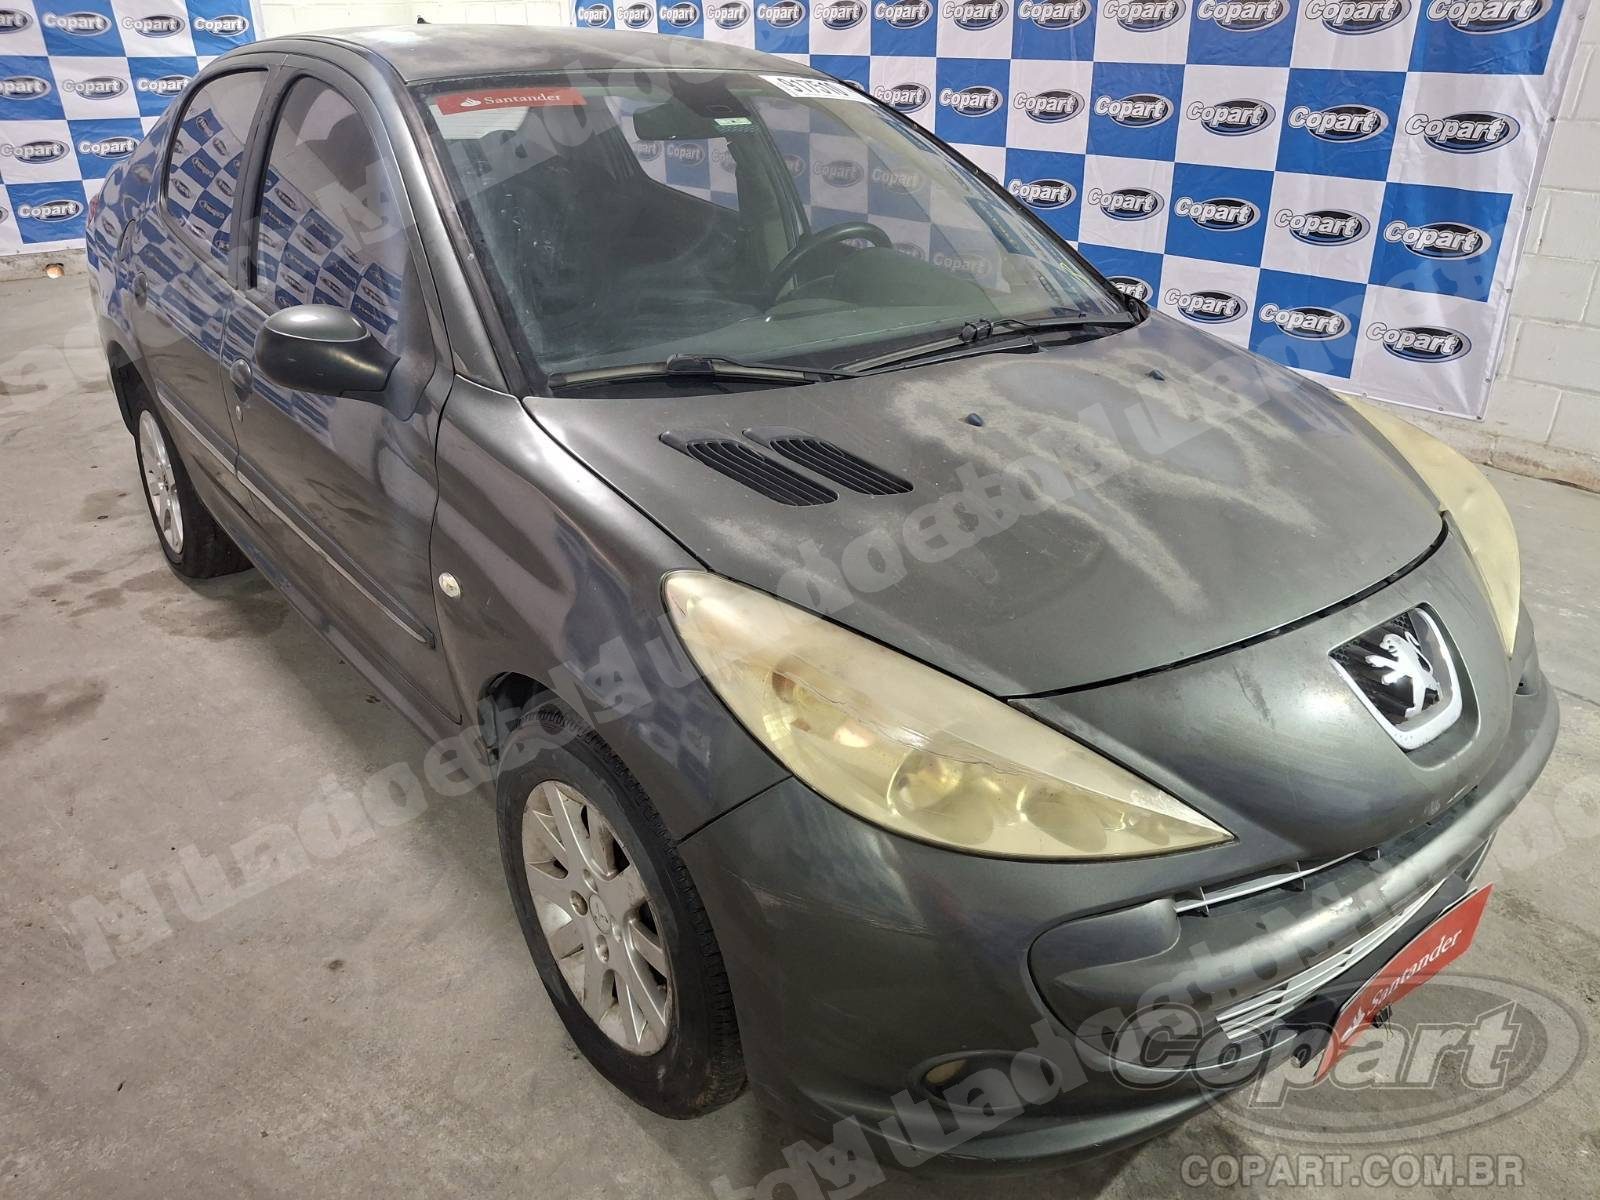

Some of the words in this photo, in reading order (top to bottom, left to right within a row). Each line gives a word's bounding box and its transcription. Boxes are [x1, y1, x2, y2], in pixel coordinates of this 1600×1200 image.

[578, 4, 608, 21] Copart
[617, 4, 649, 21] Copart
[659, 3, 696, 21] Copart
[705, 3, 745, 22] Copart
[757, 2, 800, 21] Copart
[813, 0, 859, 22] Copart
[875, 0, 927, 21] Copart
[942, 0, 1000, 22] Copart
[1018, 0, 1082, 22] Copart
[1103, 0, 1174, 22] Copart
[1197, 0, 1277, 24] Copart
[1305, 0, 1395, 25] Copart
[1427, 0, 1534, 26] Copart
[44, 13, 104, 32] Copart
[122, 17, 177, 31] Copart
[194, 17, 243, 31] Copart
[0, 79, 44, 96] part
[62, 79, 121, 95] Copart
[874, 86, 923, 106] Copart
[484, 93, 562, 106] Santander
[939, 88, 996, 111] Copart
[1013, 92, 1077, 115] Copart
[1094, 96, 1168, 120] Copart
[1186, 101, 1265, 127] Copart
[1289, 106, 1378, 133] Copart
[1405, 114, 1505, 143] Copart
[1, 144, 62, 158] Copart
[78, 140, 135, 156] Copart
[1008, 179, 1070, 204] Copart
[1087, 188, 1156, 213] Copart
[17, 204, 77, 219] Copart
[1175, 197, 1251, 223] Copart
[1274, 208, 1360, 237] Copart
[1383, 220, 1482, 252] Copart
[1164, 288, 1239, 317] Copart
[1258, 303, 1343, 334] Copart
[1366, 321, 1461, 355] Copart
[1367, 929, 1463, 1016] Santander
